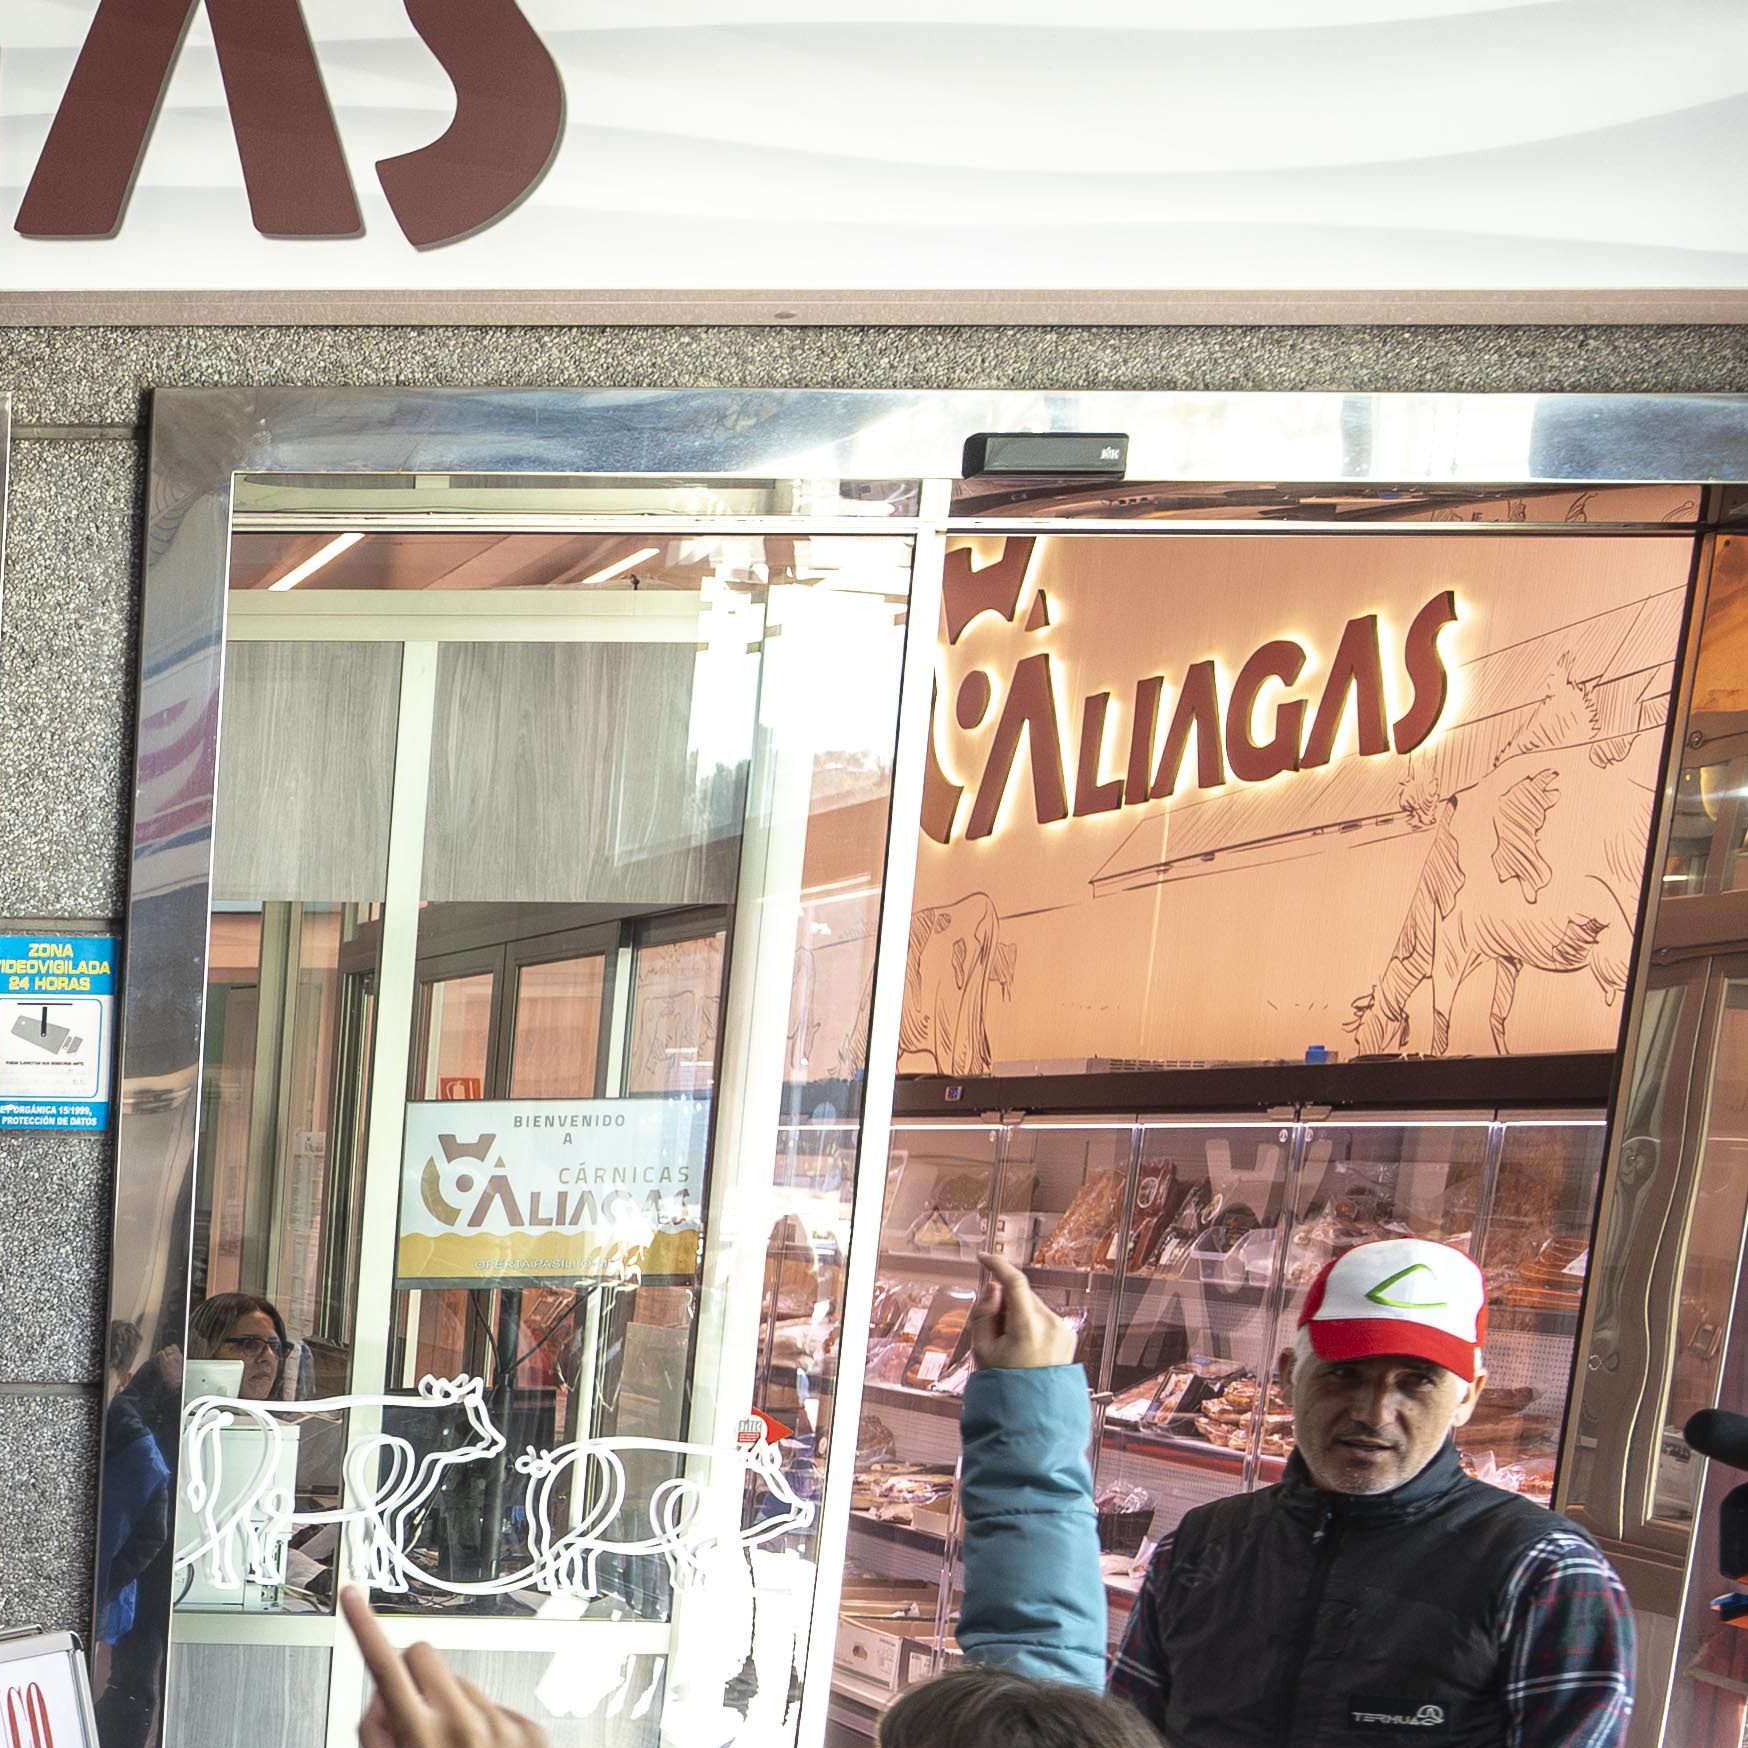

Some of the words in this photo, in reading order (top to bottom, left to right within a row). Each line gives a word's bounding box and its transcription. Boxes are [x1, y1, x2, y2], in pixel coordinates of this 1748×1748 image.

[28, 943, 74, 958] ZONA
[8, 977, 30, 991] 24
[35, 977, 91, 991] HORAS
[2, 1115, 55, 1126] PROTECCIÓN
[57, 1117, 68, 1125] DE
[70, 1117, 97, 1126] DATOS
[514, 1114, 626, 1128] BIENVENIDO
[563, 1132, 573, 1145] A
[559, 1162, 690, 1185] CÁRNICAS
